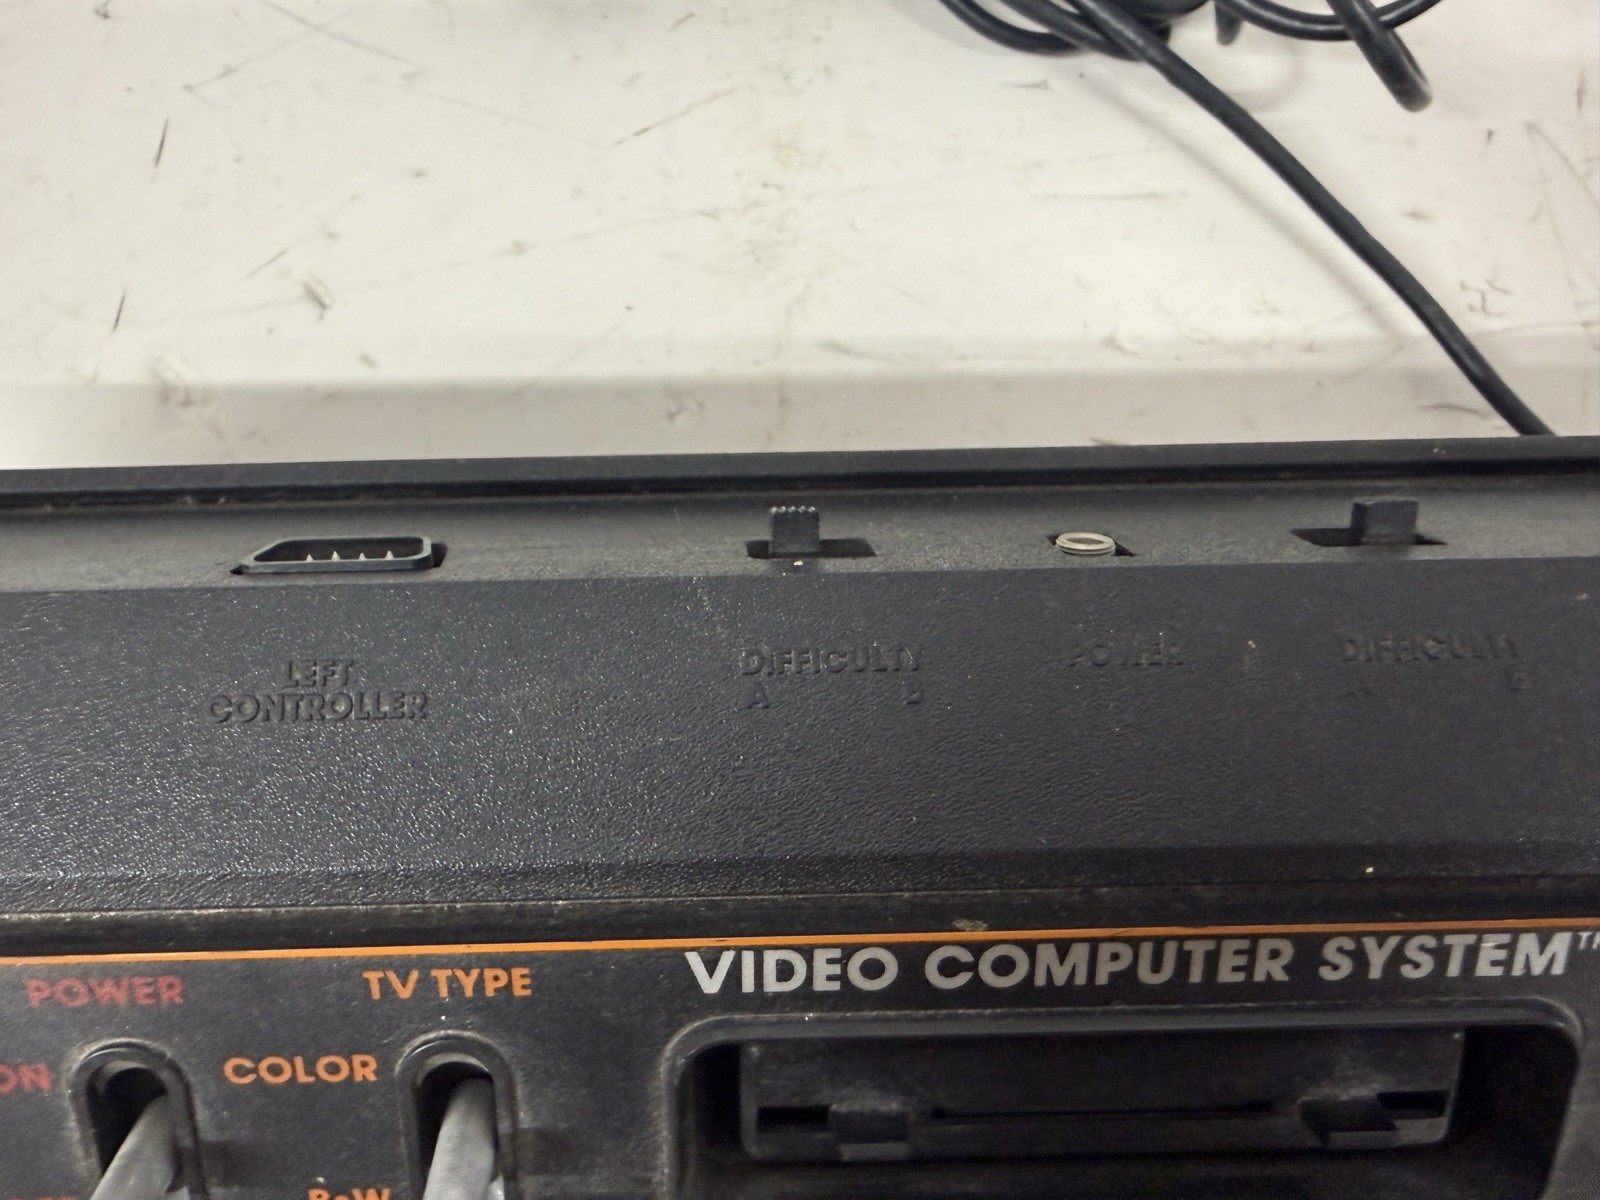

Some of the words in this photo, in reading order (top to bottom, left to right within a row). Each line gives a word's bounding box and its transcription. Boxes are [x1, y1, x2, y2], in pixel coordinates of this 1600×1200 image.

[283, 658, 355, 688] LEFT
[740, 648, 922, 676] DIFFICULTY
[207, 690, 430, 724] CONTROLLER
[684, 946, 898, 994] VIDEO
[924, 936, 1295, 990] COMPUTER
[1318, 931, 1572, 981] SYSTEM
[23, 975, 184, 1008] POWER
[362, 969, 419, 1000] TV
[429, 966, 533, 998] TYPE
[223, 1053, 379, 1085] COLOR
